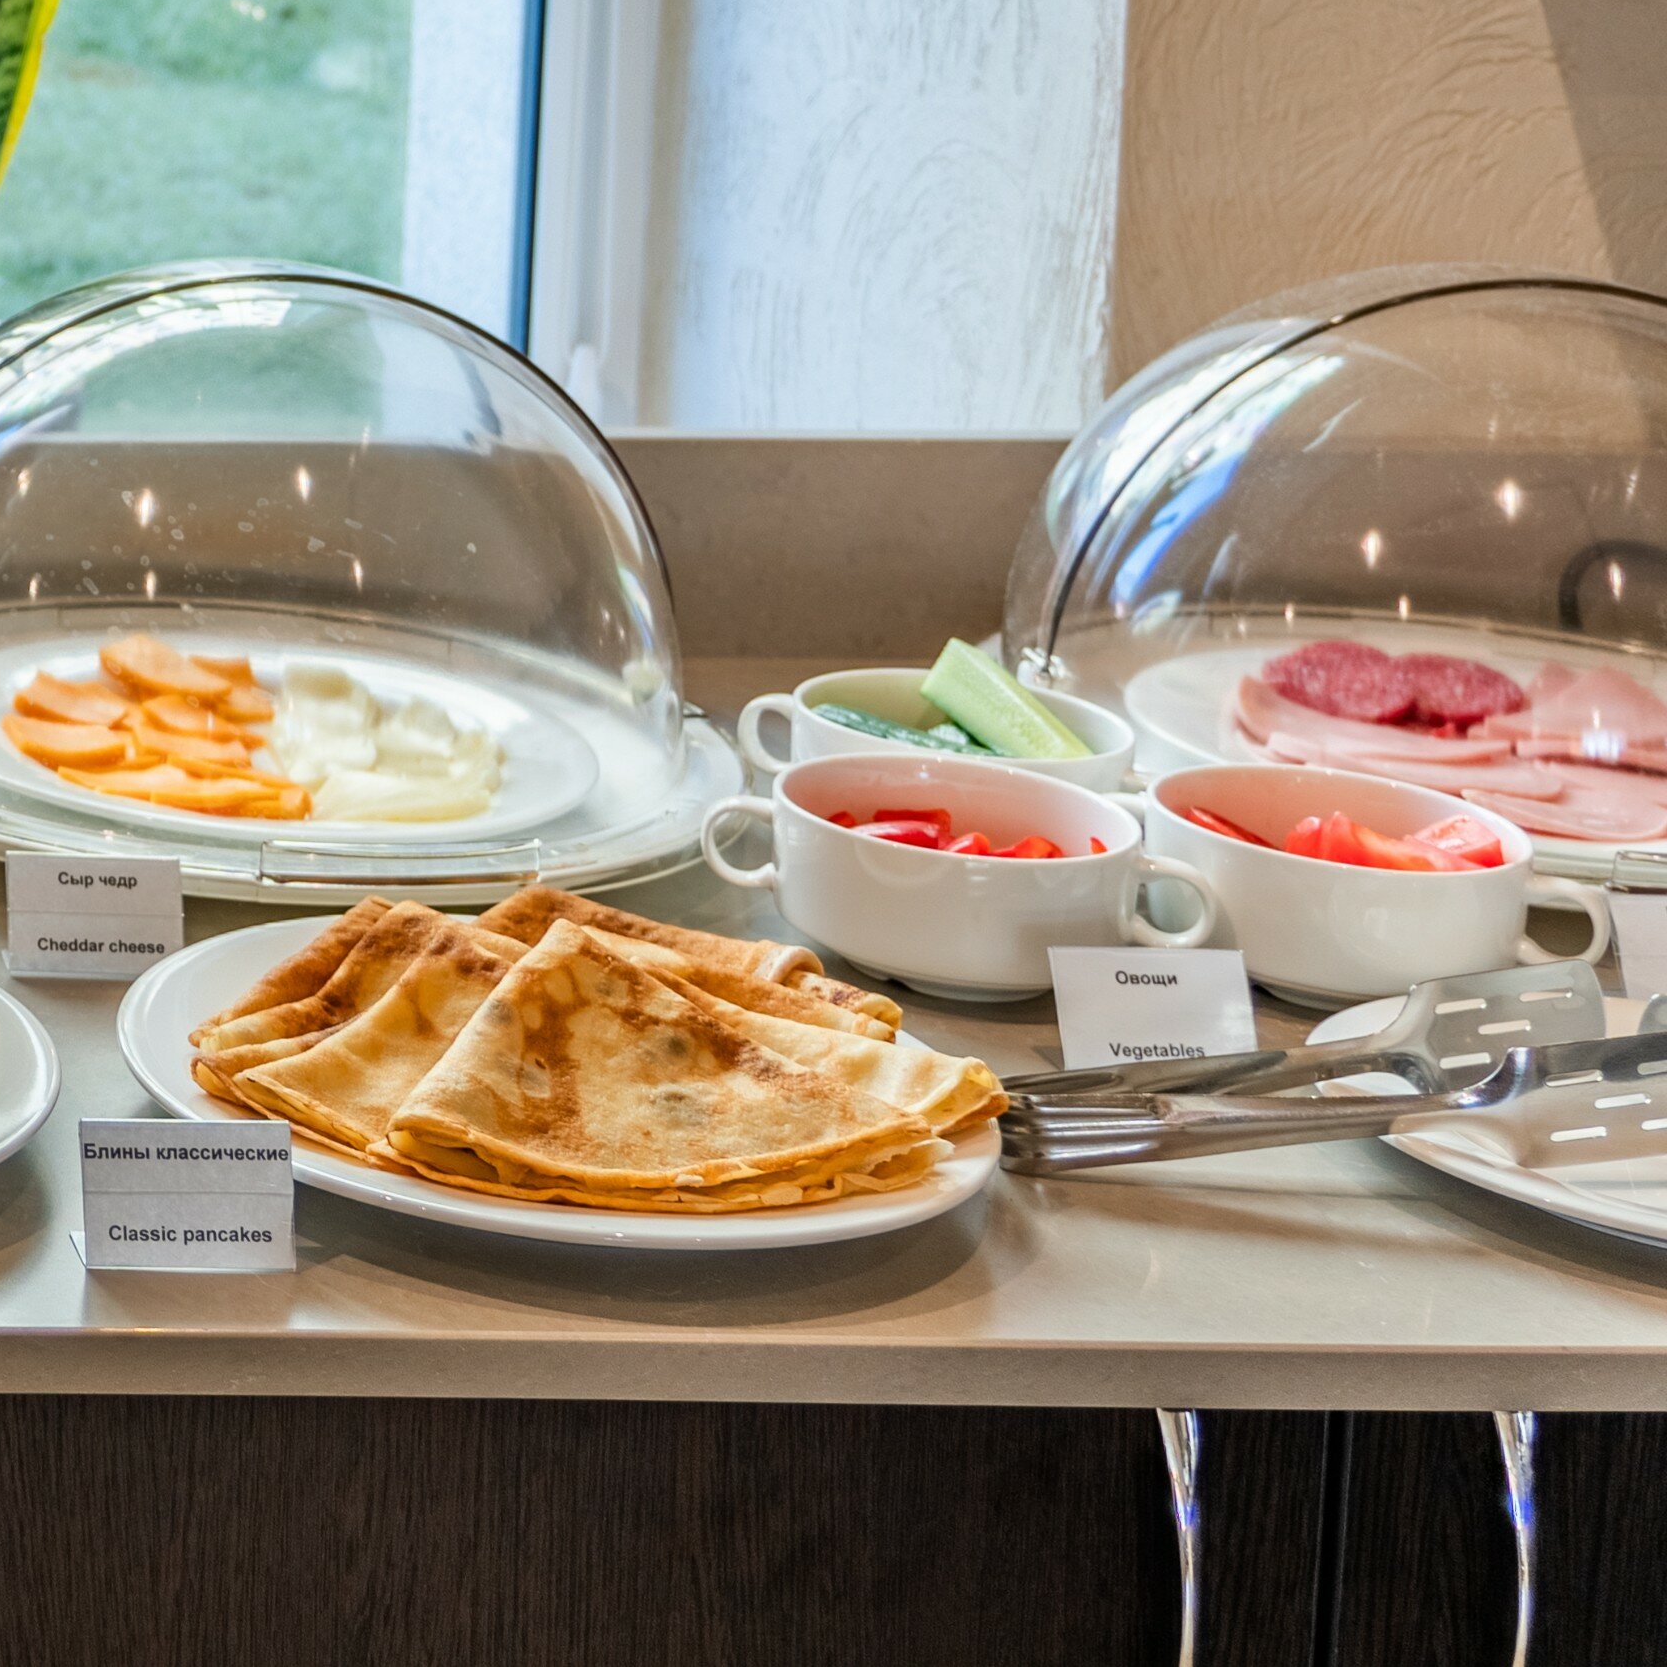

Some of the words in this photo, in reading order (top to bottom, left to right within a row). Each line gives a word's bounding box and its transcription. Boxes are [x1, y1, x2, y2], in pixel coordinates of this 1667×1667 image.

[57, 871, 94, 889] Сыр
[98, 875, 138, 890] чедр
[37, 937, 105, 953] Cheddar
[108, 939, 165, 955] cheese
[1114, 970, 1178, 987] Овощи
[1109, 1043, 1206, 1059] Vegetables
[83, 1142, 150, 1160] Блины
[156, 1147, 289, 1161] классические
[108, 1224, 177, 1242] Classic
[183, 1226, 273, 1246] pancakes
